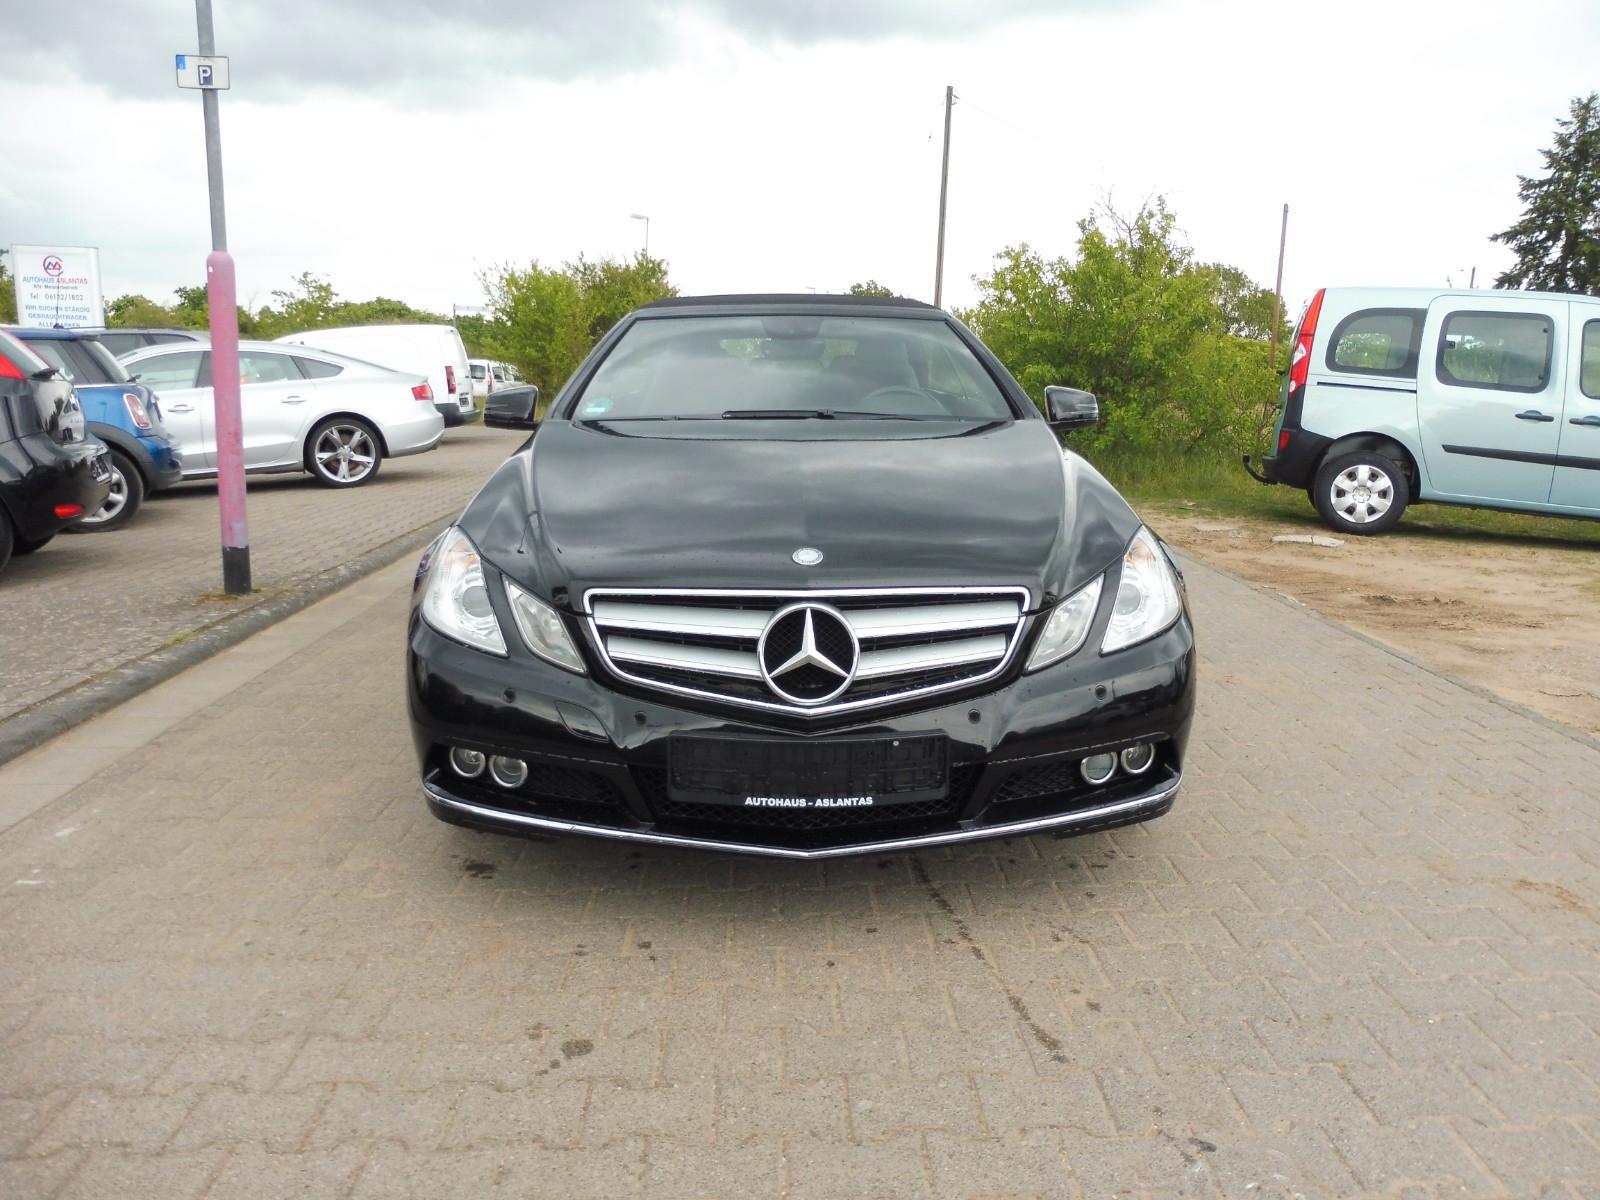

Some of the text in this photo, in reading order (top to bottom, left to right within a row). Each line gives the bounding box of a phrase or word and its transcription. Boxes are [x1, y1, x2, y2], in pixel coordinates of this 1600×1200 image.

[200, 66, 211, 84] P
[23, 276, 55, 284] AUTOHAUS
[744, 797, 806, 807] AUTOHAUS
[815, 796, 873, 807] ASLANTAS
